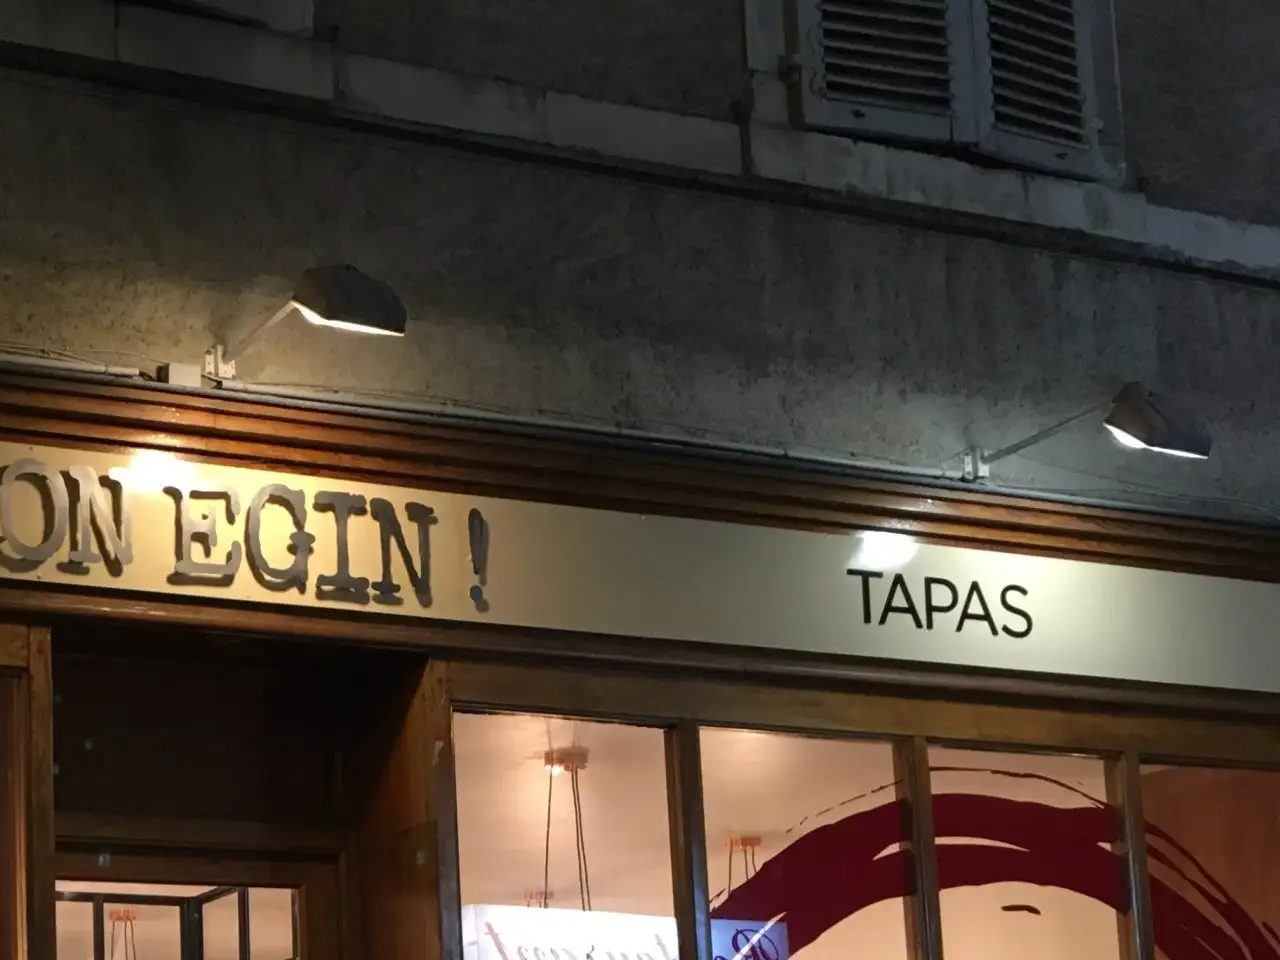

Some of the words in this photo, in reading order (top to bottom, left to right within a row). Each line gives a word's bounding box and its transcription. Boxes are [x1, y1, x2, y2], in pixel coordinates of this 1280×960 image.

[161, 483, 439, 608] EGIN
[467, 506, 490, 613] !
[846, 568, 1033, 639] TAPAS
